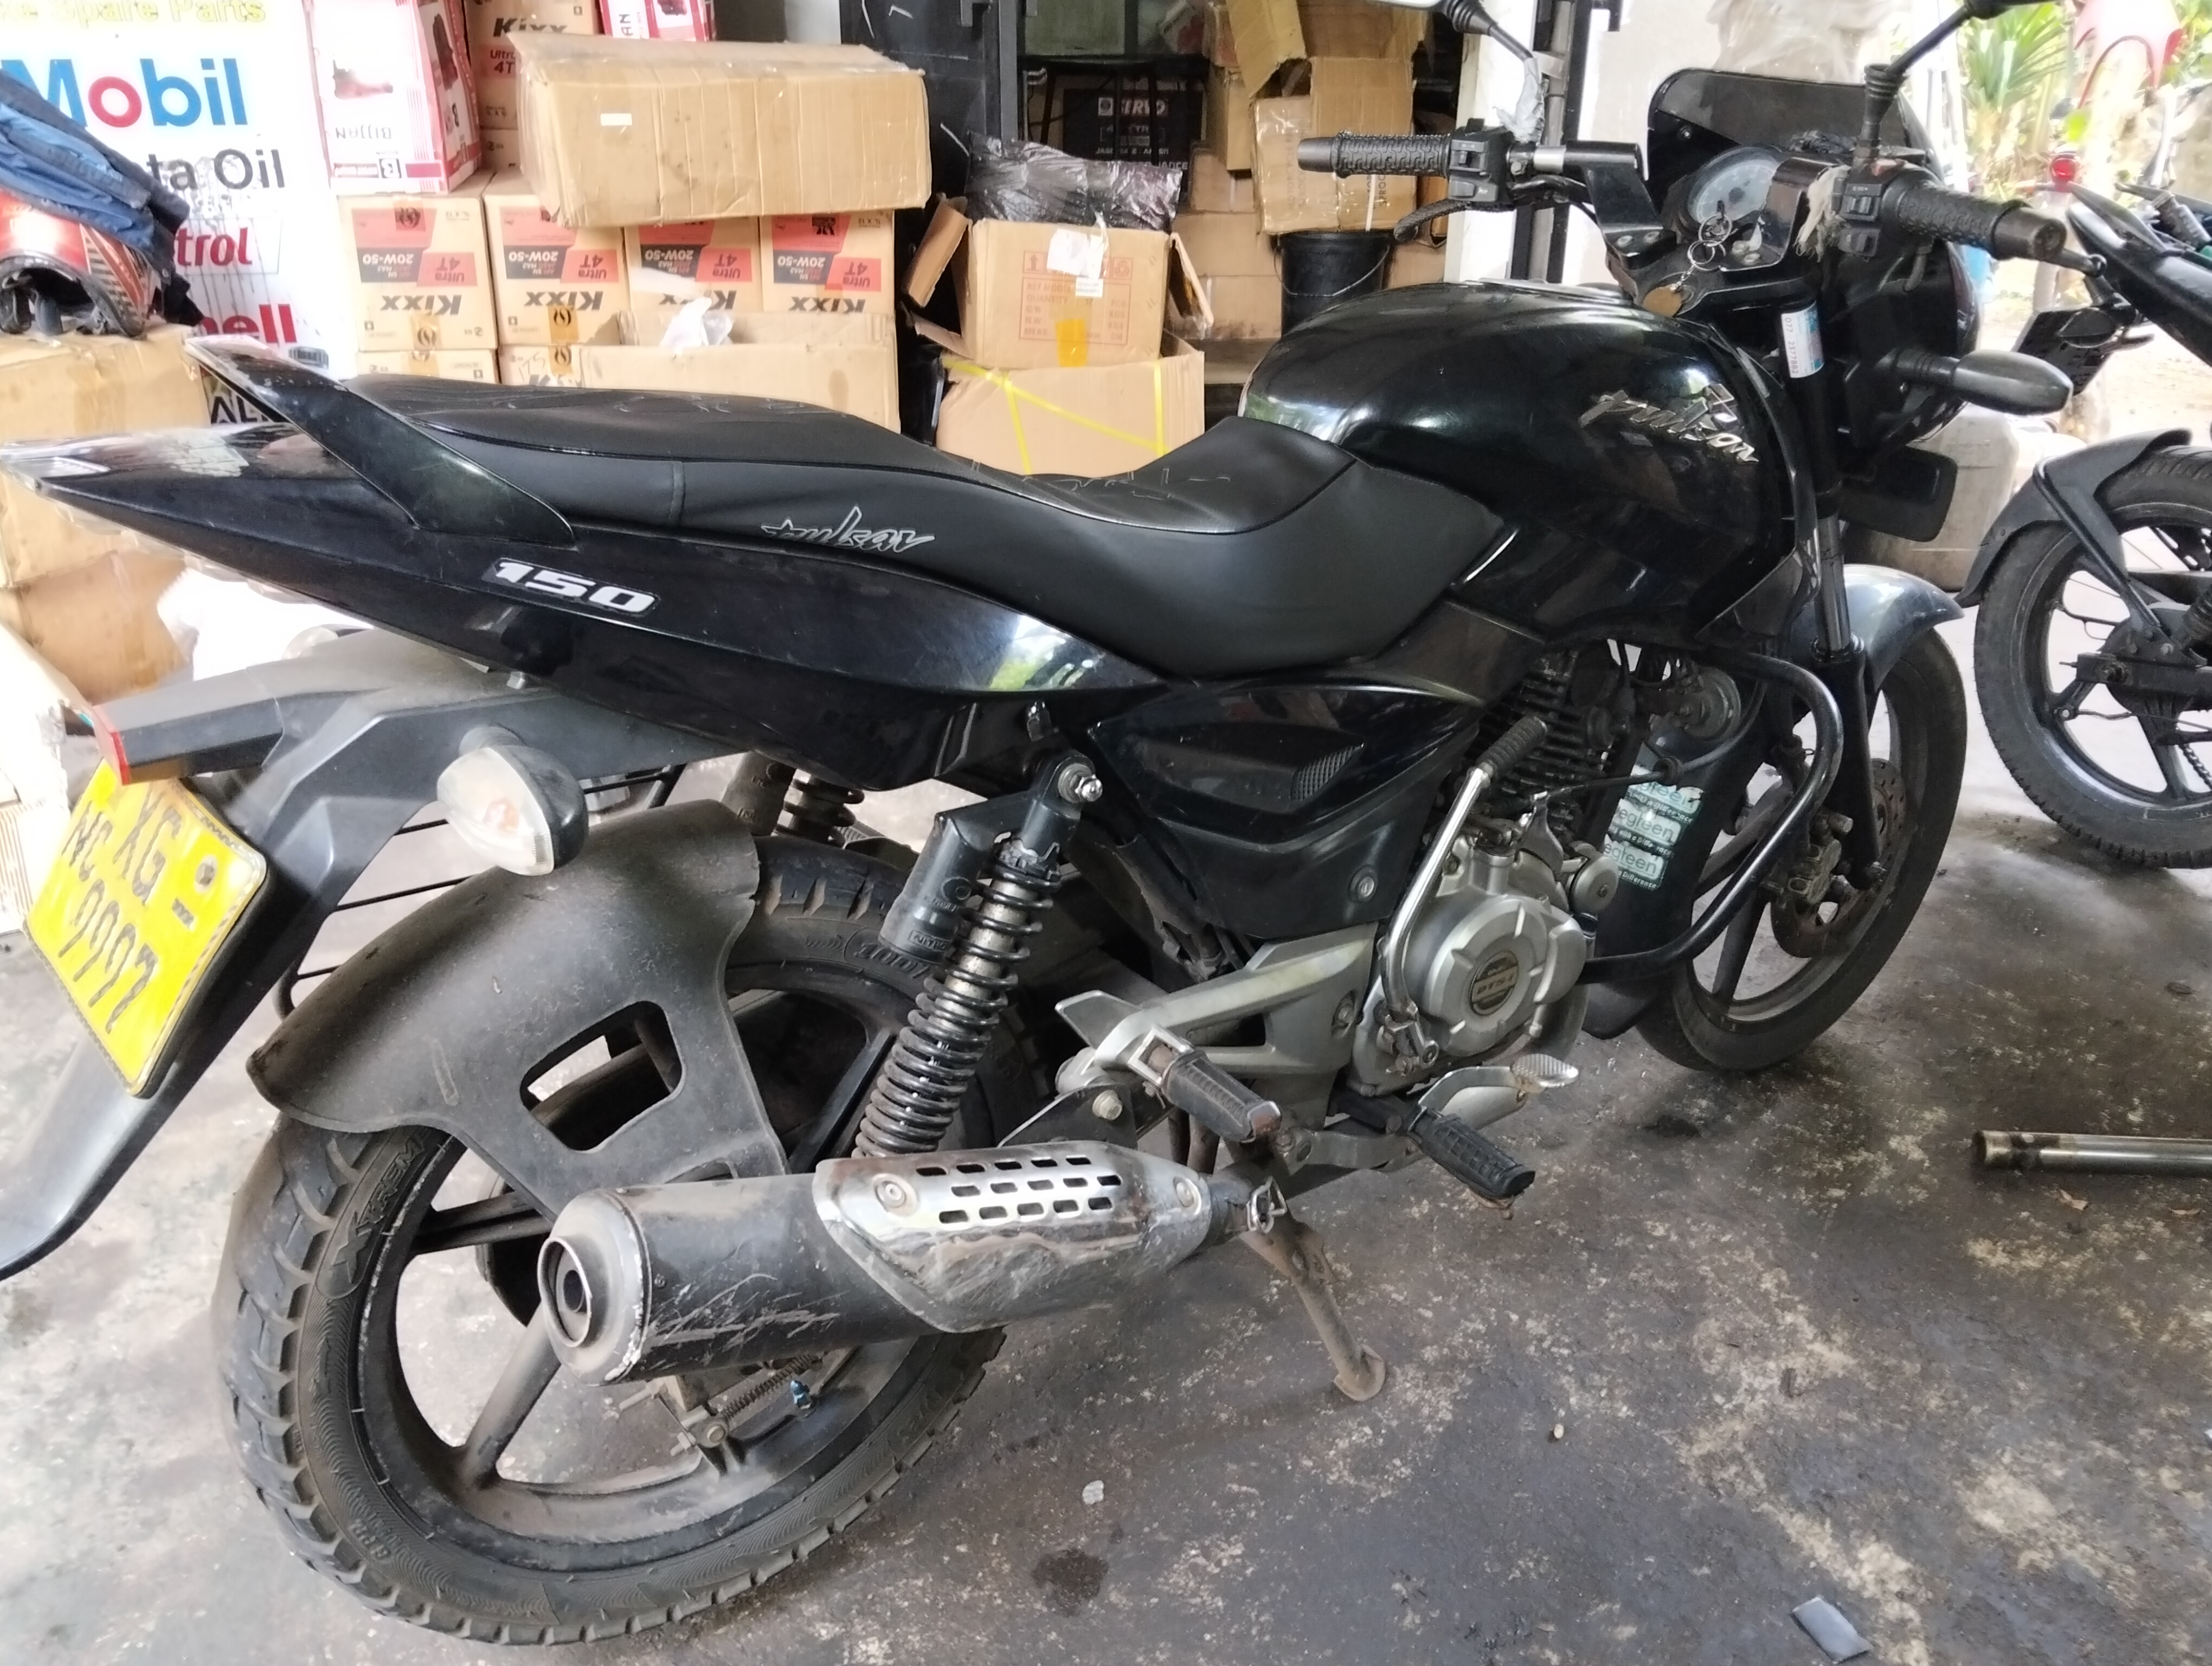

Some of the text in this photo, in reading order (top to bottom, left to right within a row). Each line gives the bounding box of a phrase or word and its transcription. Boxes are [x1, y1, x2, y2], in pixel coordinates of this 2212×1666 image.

[169, 0, 266, 23] Parts
[0, 58, 248, 128] Mobil
[214, 148, 285, 189] Oil
[362, 253, 414, 265] 20W-50
[508, 251, 559, 262] 20W-50
[579, 254, 605, 268] 4T
[644, 249, 695, 261] 20W-50
[713, 253, 737, 267] 4T
[777, 255, 826, 268] 20W-50
[436, 257, 461, 271] 4T
[844, 261, 868, 276] 4T
[435, 271, 465, 283] Ultra
[578, 268, 607, 280] Ultra
[712, 268, 741, 279] Ultra
[843, 277, 871, 289] Ultra
[380, 294, 462, 317] Kixx
[523, 291, 603, 311] Kixx
[788, 296, 866, 314] Kixx
[496, 560, 655, 613] 150
[57, 879, 158, 1035] 9997
